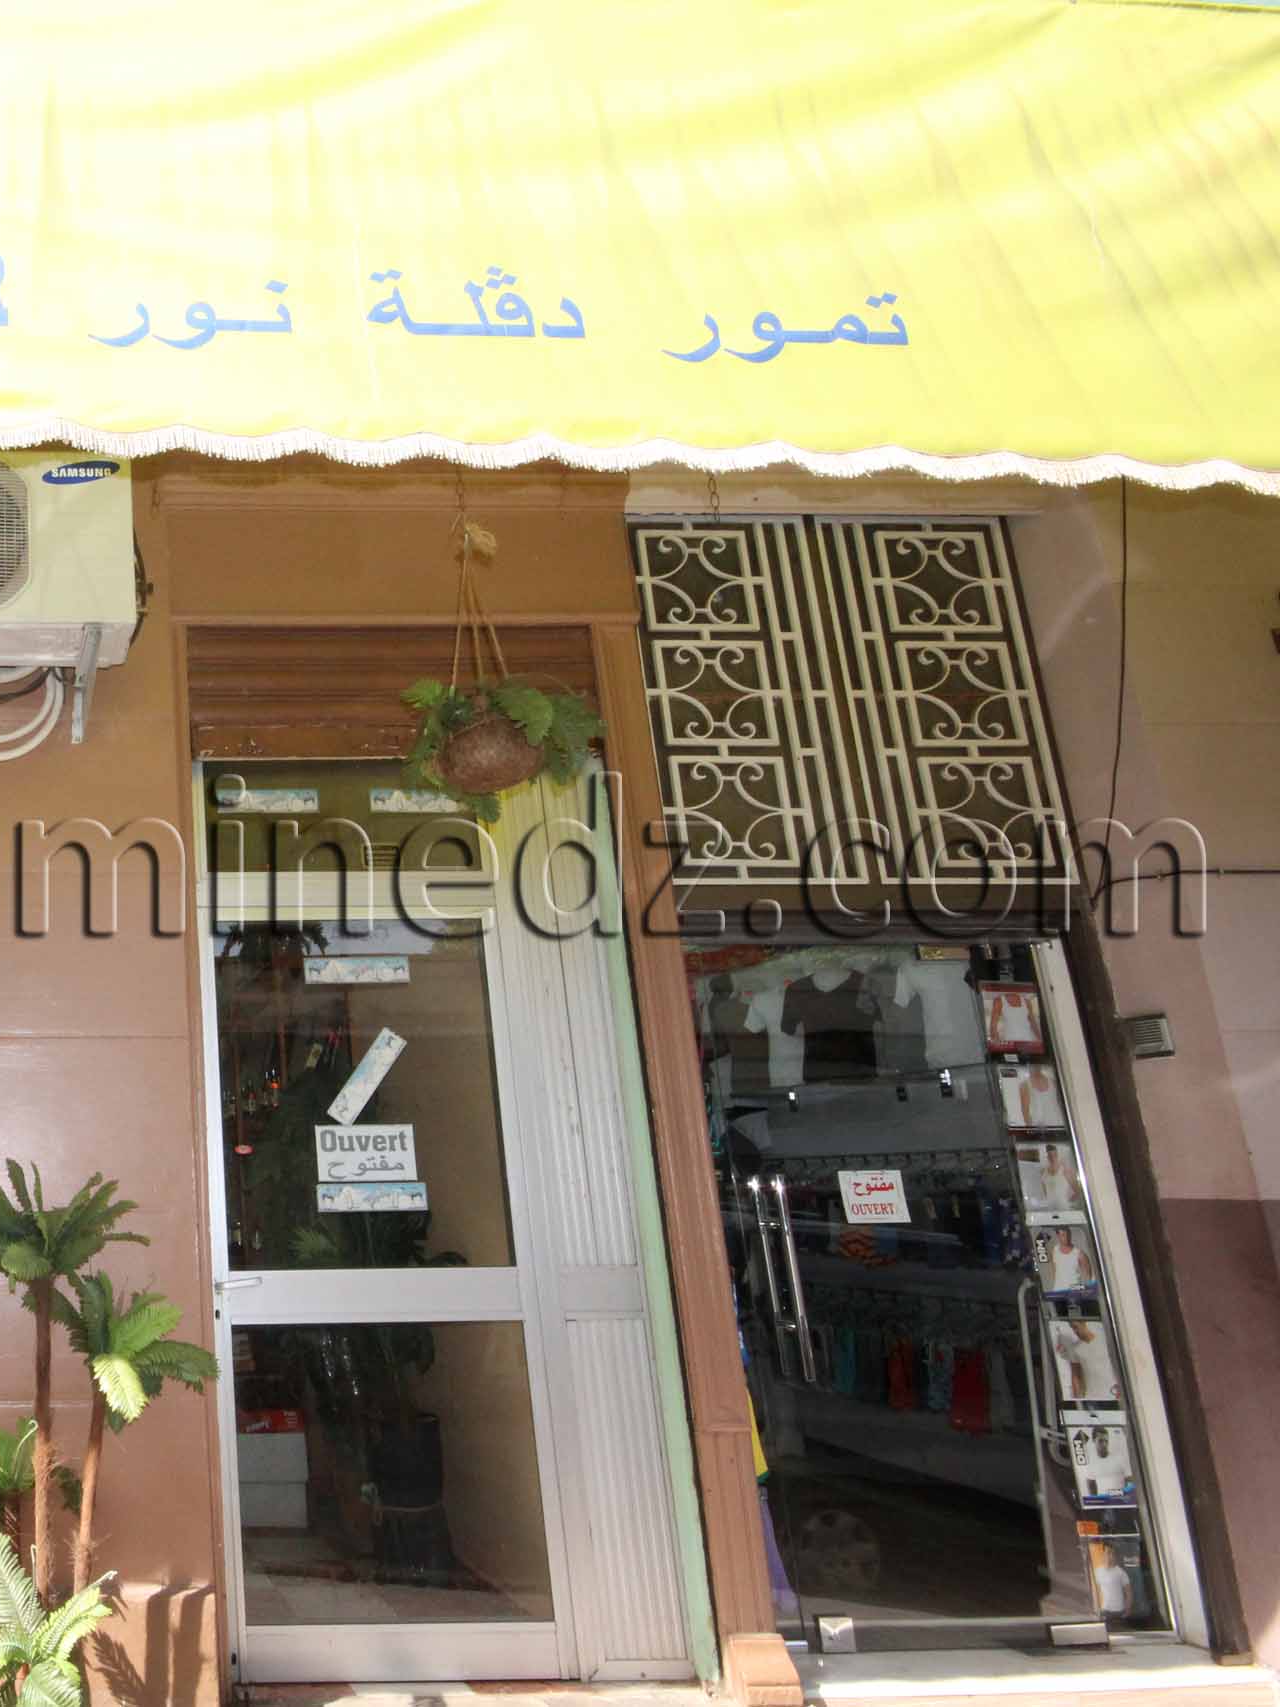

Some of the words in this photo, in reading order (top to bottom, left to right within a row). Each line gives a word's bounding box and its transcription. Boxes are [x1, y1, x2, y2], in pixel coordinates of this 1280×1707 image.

[87, 279, 292, 350] نور
[660, 291, 909, 364] تمور
[51, 466, 113, 478] SAMSUNG
[321, 1129, 408, 1153] Ouvert
[327, 1155, 405, 1180] مفتوح
[852, 1177, 895, 1197] مفتوح
[851, 1202, 895, 1216] OUVERT
[1036, 1239, 1049, 1263] DIM
[1073, 1439, 1087, 1465] DIM
